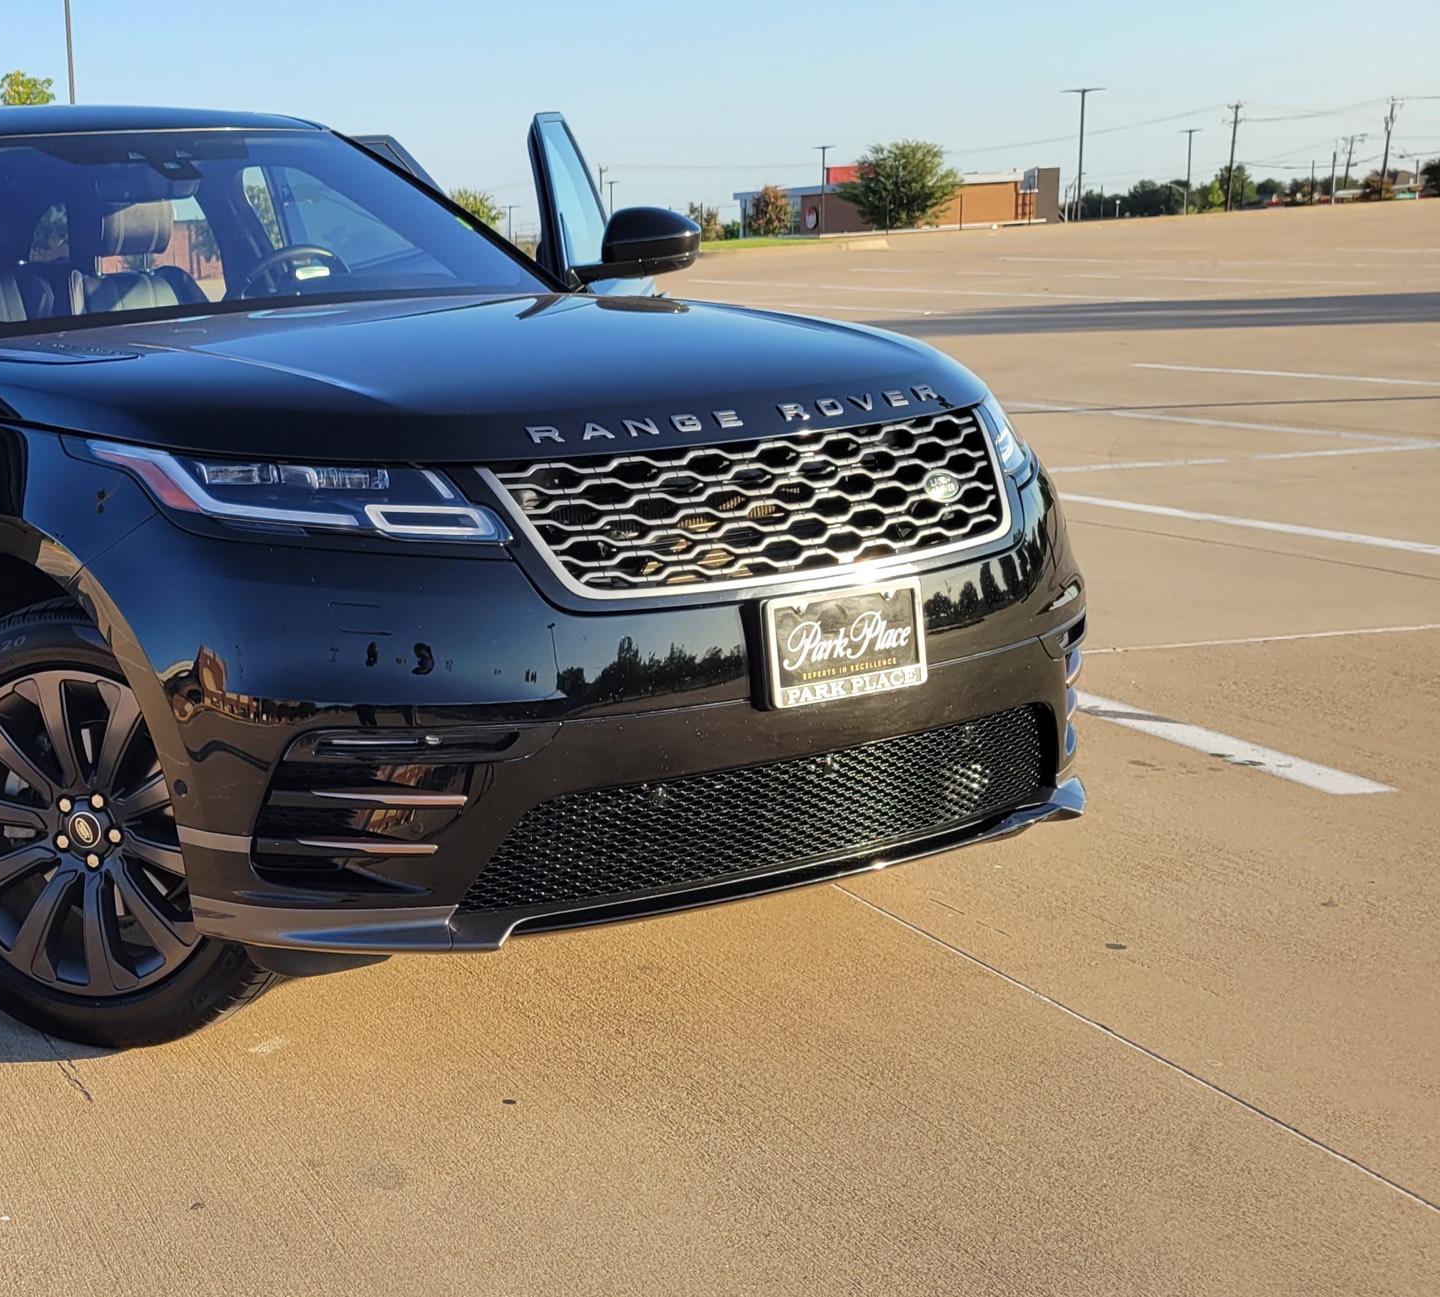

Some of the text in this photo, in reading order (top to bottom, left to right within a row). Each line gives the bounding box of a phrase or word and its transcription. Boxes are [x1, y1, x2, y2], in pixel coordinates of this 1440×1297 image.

[525, 383, 938, 444] RANGE ROVER
[783, 610, 911, 671] Park Place
[786, 668, 917, 705] PARK PLACE
[803, 657, 897, 681] EXPERTS IN EXCELLENCE
